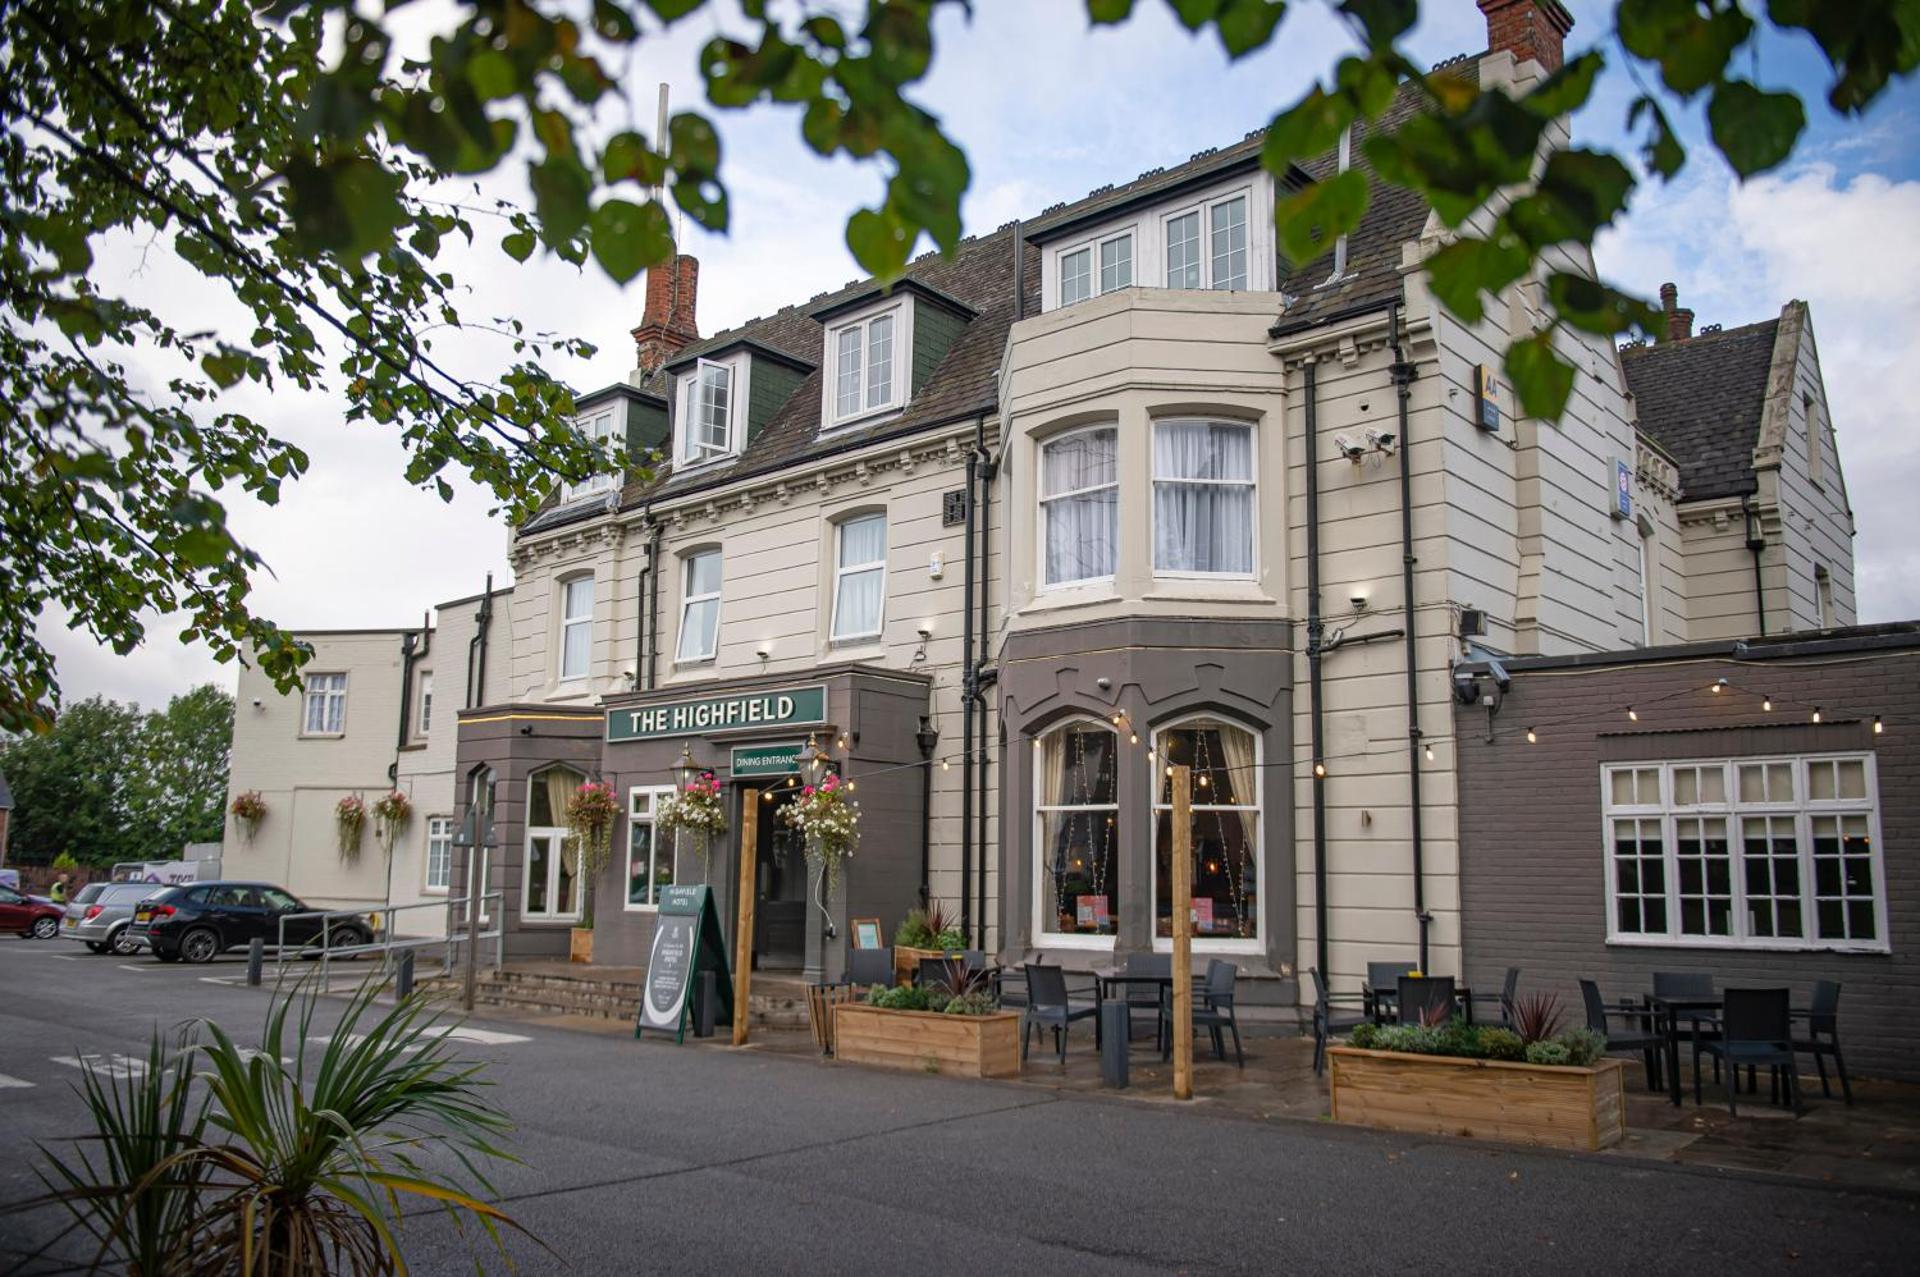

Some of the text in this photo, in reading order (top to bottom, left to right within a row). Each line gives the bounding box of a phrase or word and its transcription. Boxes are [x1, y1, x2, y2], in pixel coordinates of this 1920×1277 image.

[1485, 375, 1498, 398] AA
[630, 696, 795, 734] THE HIGHFIELD
[736, 753, 801, 768] DINING ENTRANC
